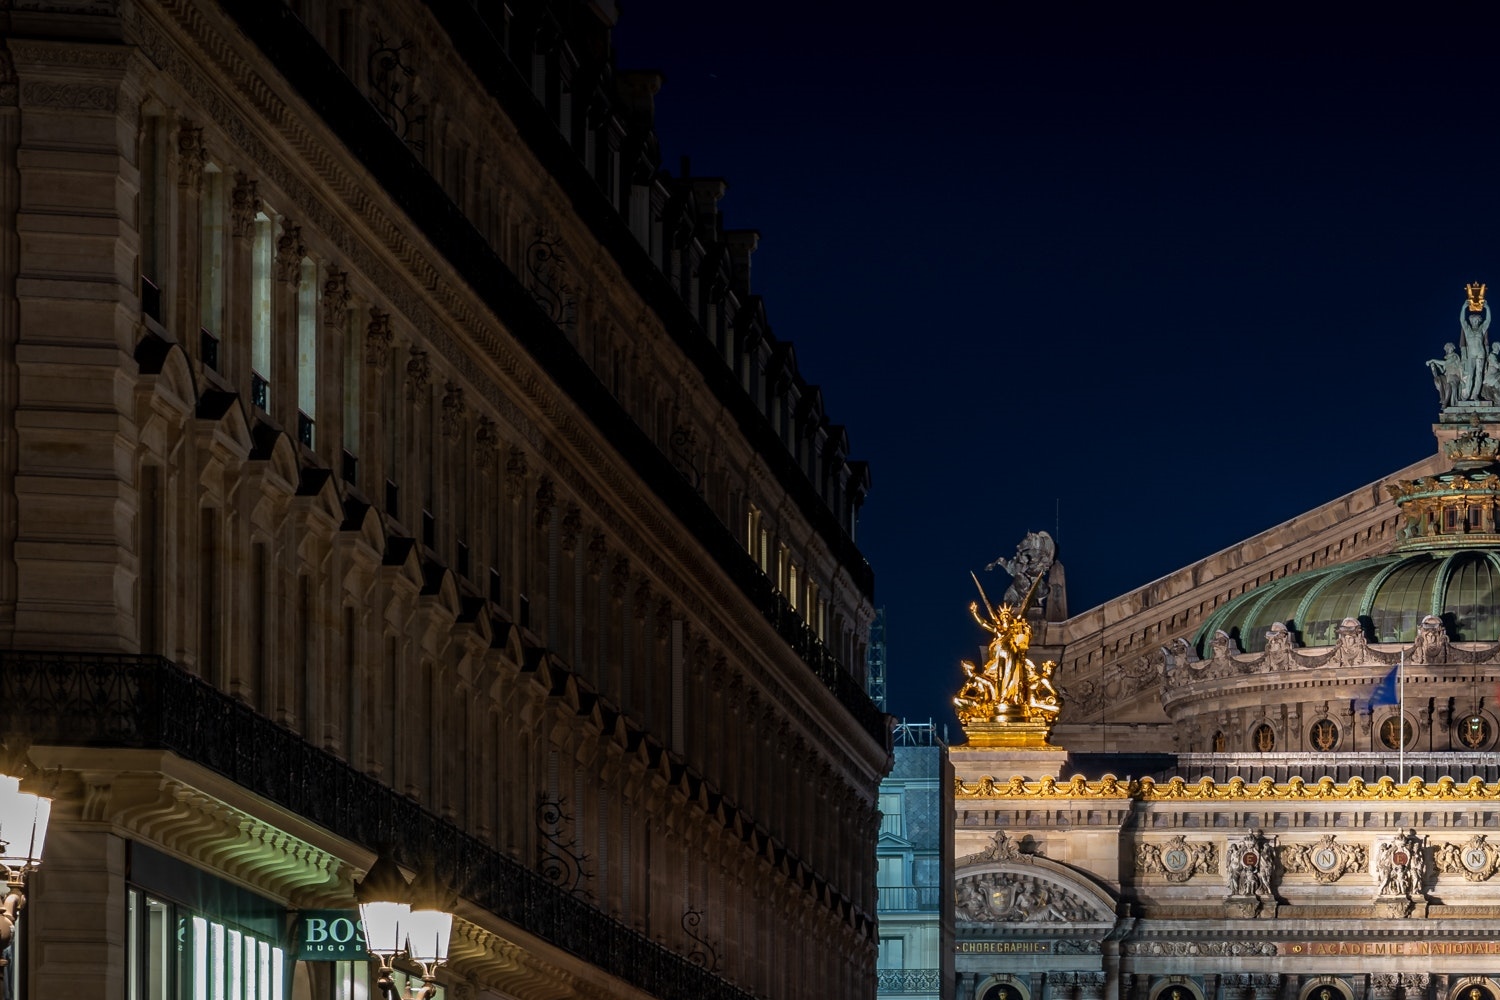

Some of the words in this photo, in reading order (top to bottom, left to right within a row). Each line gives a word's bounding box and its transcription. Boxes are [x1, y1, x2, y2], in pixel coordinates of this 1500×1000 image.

[305, 918, 366, 943] BOS
[962, 942, 1040, 952] CHOREGRAPHIE
[1317, 943, 1404, 954] ACADEMIE
[1421, 943, 1500, 954] NATIONALE
